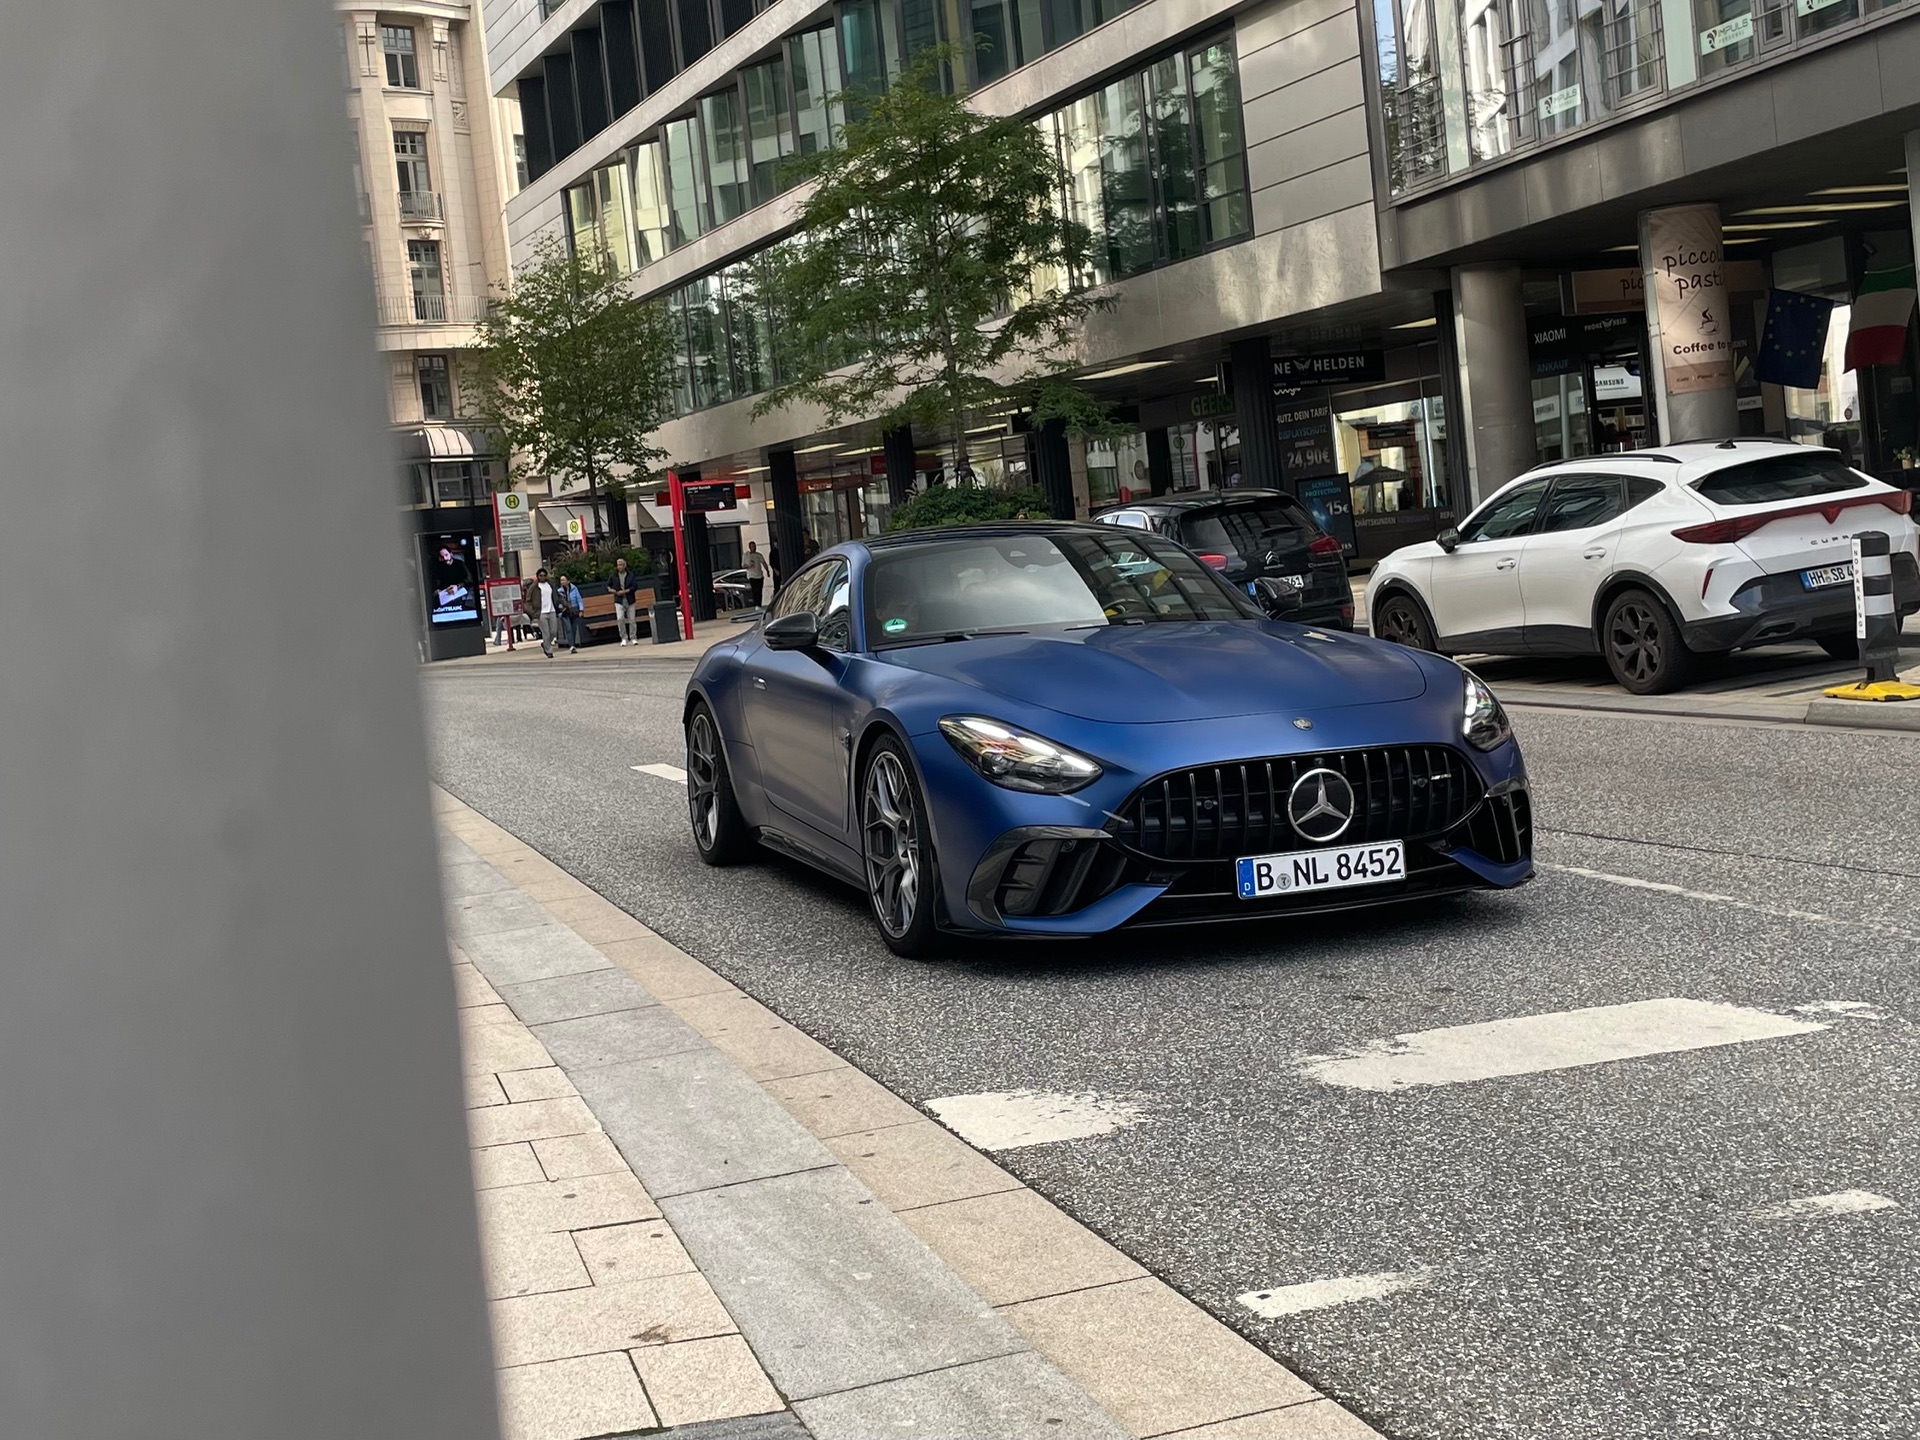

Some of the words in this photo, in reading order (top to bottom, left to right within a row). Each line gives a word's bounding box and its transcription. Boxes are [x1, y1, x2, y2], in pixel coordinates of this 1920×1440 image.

[1718, 18, 1748, 37] IMPULS
[1534, 327, 1567, 345] XIAOMI
[1673, 341, 1714, 355] Coffee
[1717, 341, 1726, 350] to
[1313, 355, 1365, 372] HELDEN
[1537, 359, 1569, 374] ANKAUF
[1595, 378, 1624, 387] SAMSUNG
[1191, 393, 1235, 417] GEERS
[1294, 410, 1310, 421] DEIN
[1278, 424, 1328, 441] DISPLAYSCHUTZ
[1287, 447, 1331, 470] 24,90€
[1305, 487, 1342, 497] PROTECTION
[1311, 480, 1334, 489] SCREEN
[1326, 500, 1350, 516] 15€
[1808, 570, 1826, 586] HH
[1830, 567, 1846, 581] SB
[1855, 569, 1863, 627] PARKING
[1244, 882, 1251, 891] D
[1256, 862, 1274, 891] B
[1293, 857, 1329, 887] NL
[1336, 847, 1402, 881] 8452
